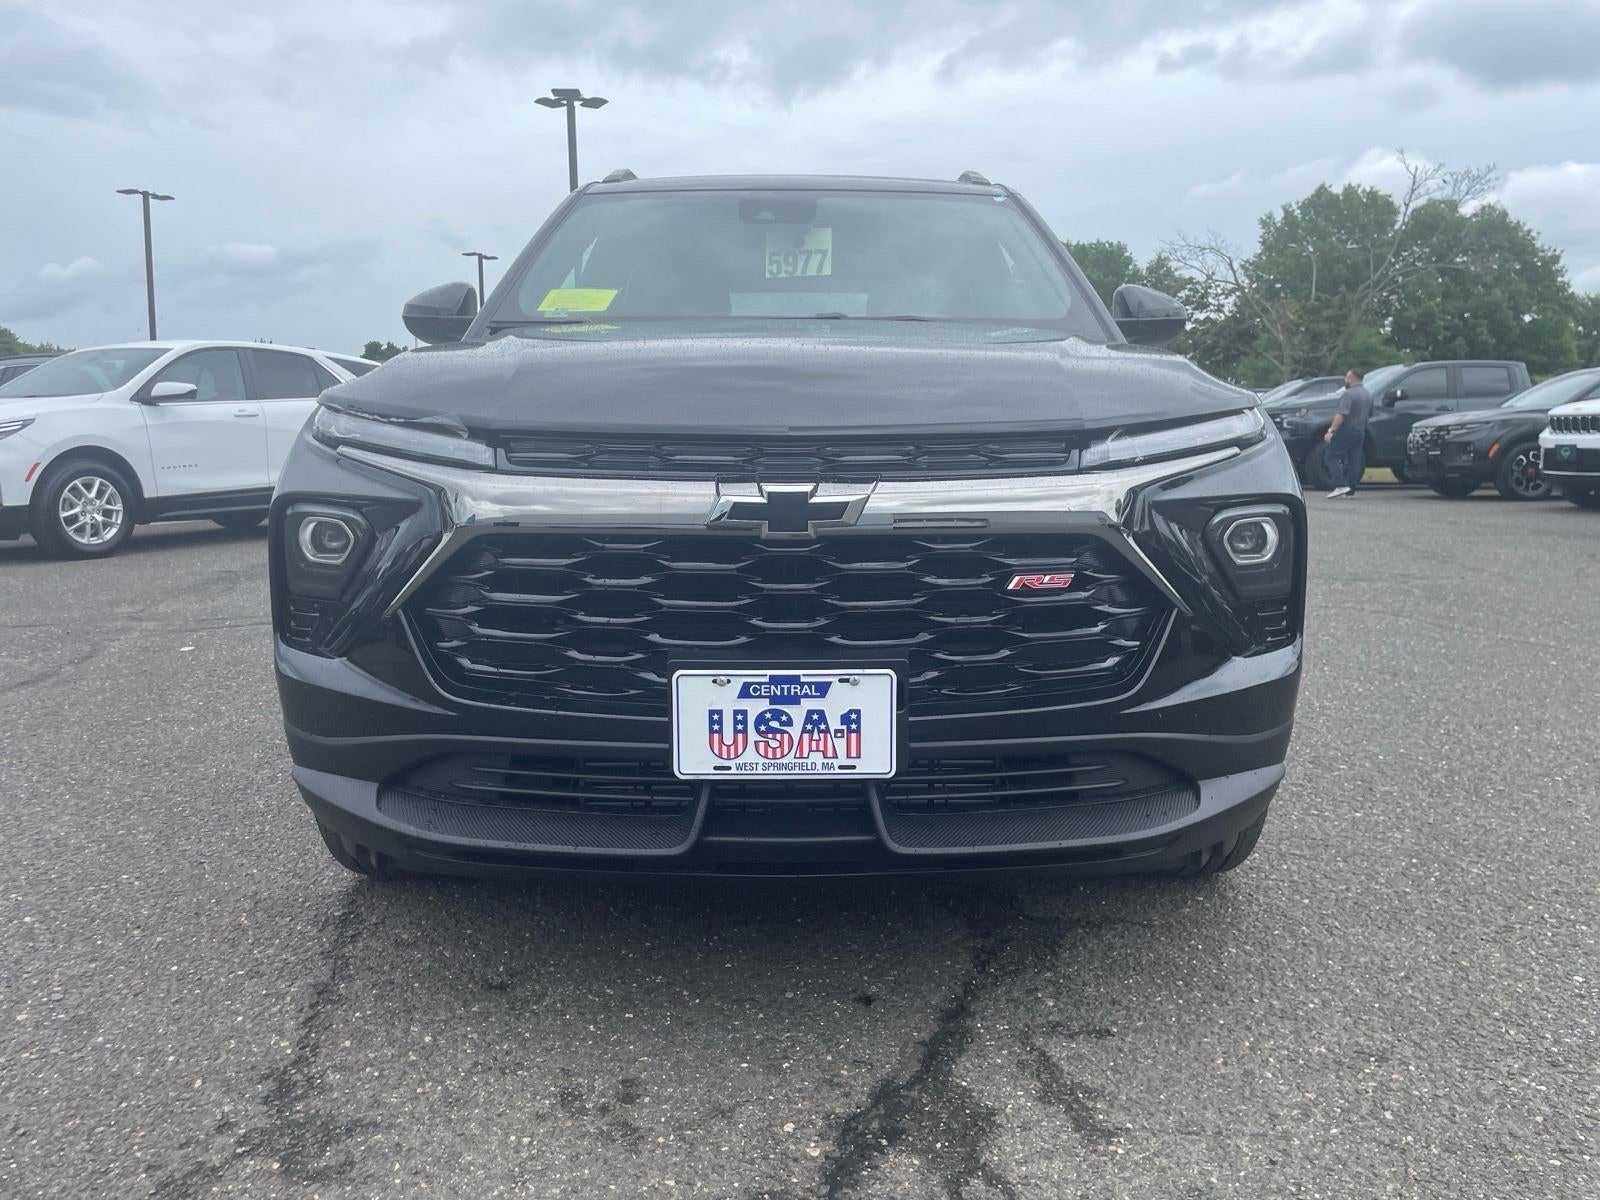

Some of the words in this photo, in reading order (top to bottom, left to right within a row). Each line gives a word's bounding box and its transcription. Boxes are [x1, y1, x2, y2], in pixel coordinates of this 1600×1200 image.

[767, 249, 829, 276] 5977
[1007, 574, 1075, 590] RS
[749, 684, 820, 696] CENTRAL
[735, 762, 759, 772] WEST
[761, 762, 819, 772] SPRINGFIELD,
[821, 762, 836, 771] MA
